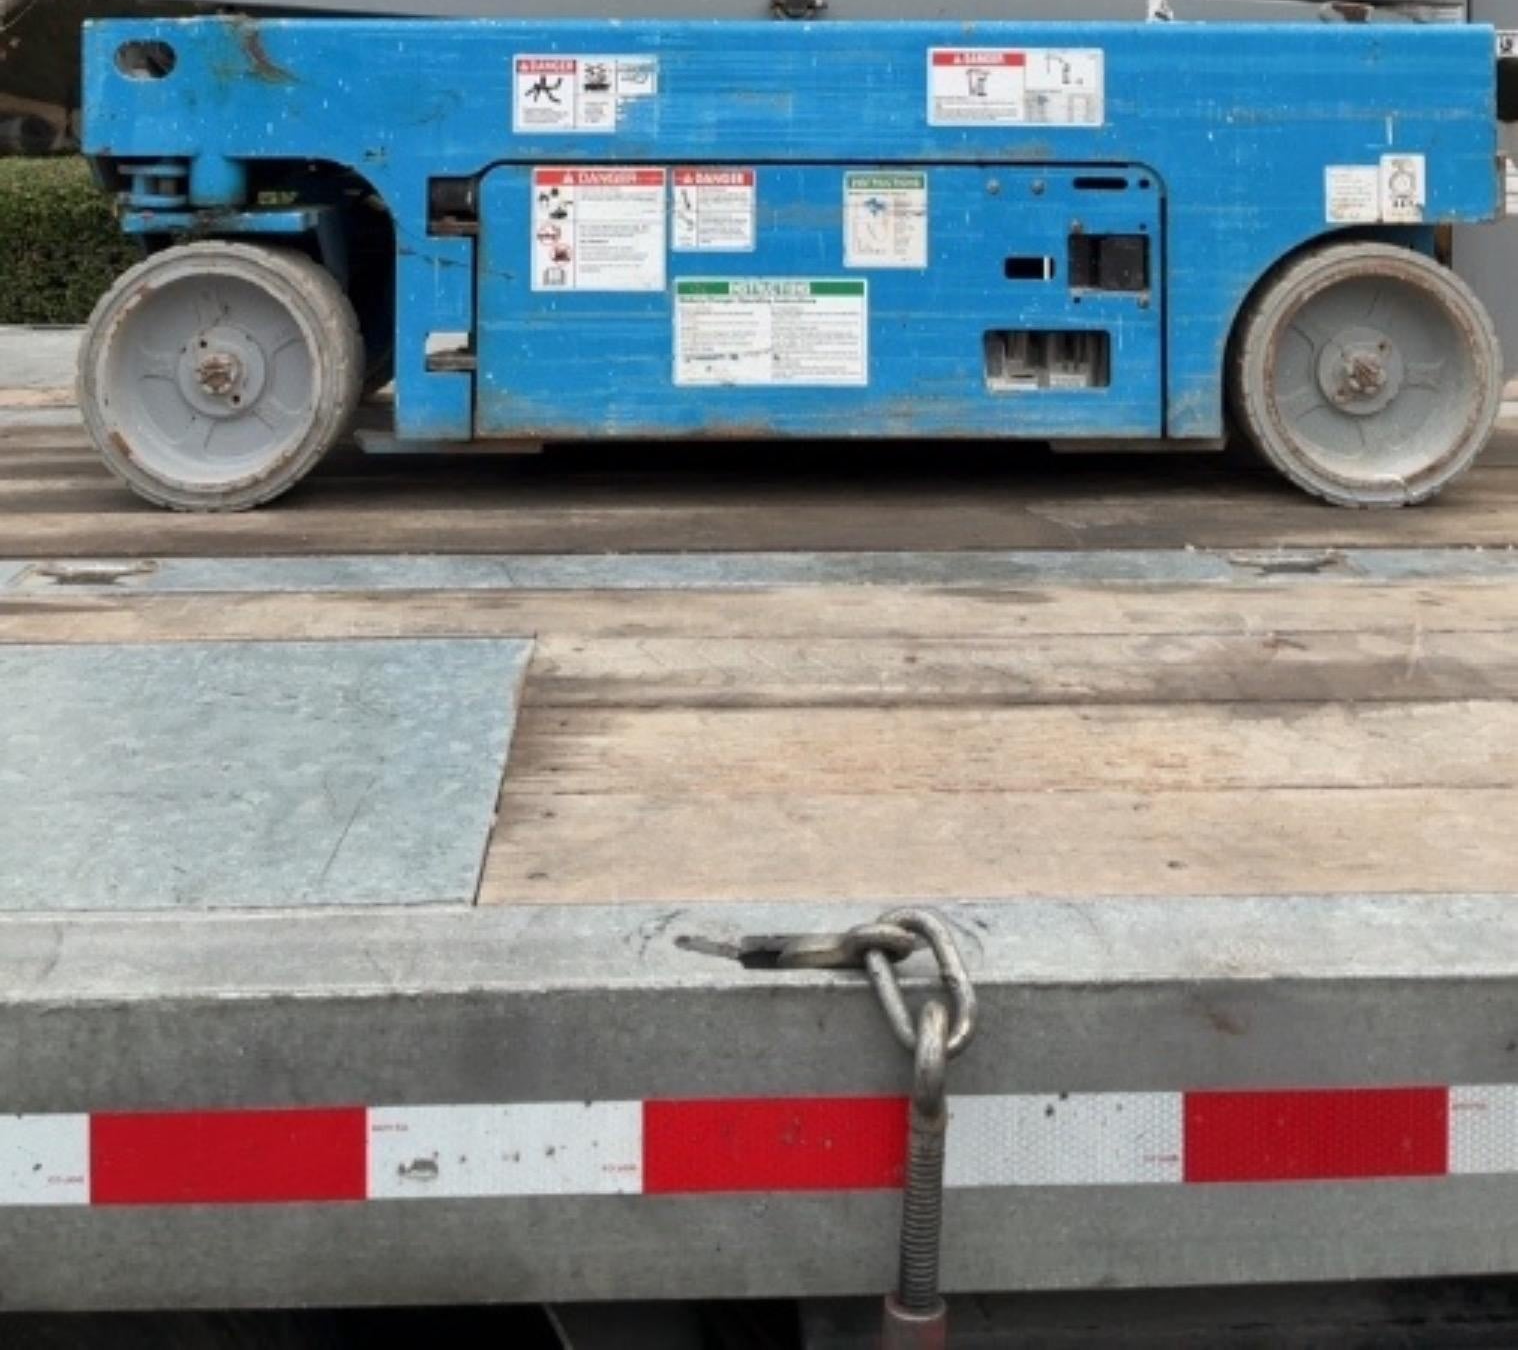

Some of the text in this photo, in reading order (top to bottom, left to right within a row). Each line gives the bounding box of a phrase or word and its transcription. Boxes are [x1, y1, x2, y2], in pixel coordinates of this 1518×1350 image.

[530, 60, 573, 72] DANGER
[578, 171, 638, 184] DANGER
[695, 170, 745, 184] DANGER
